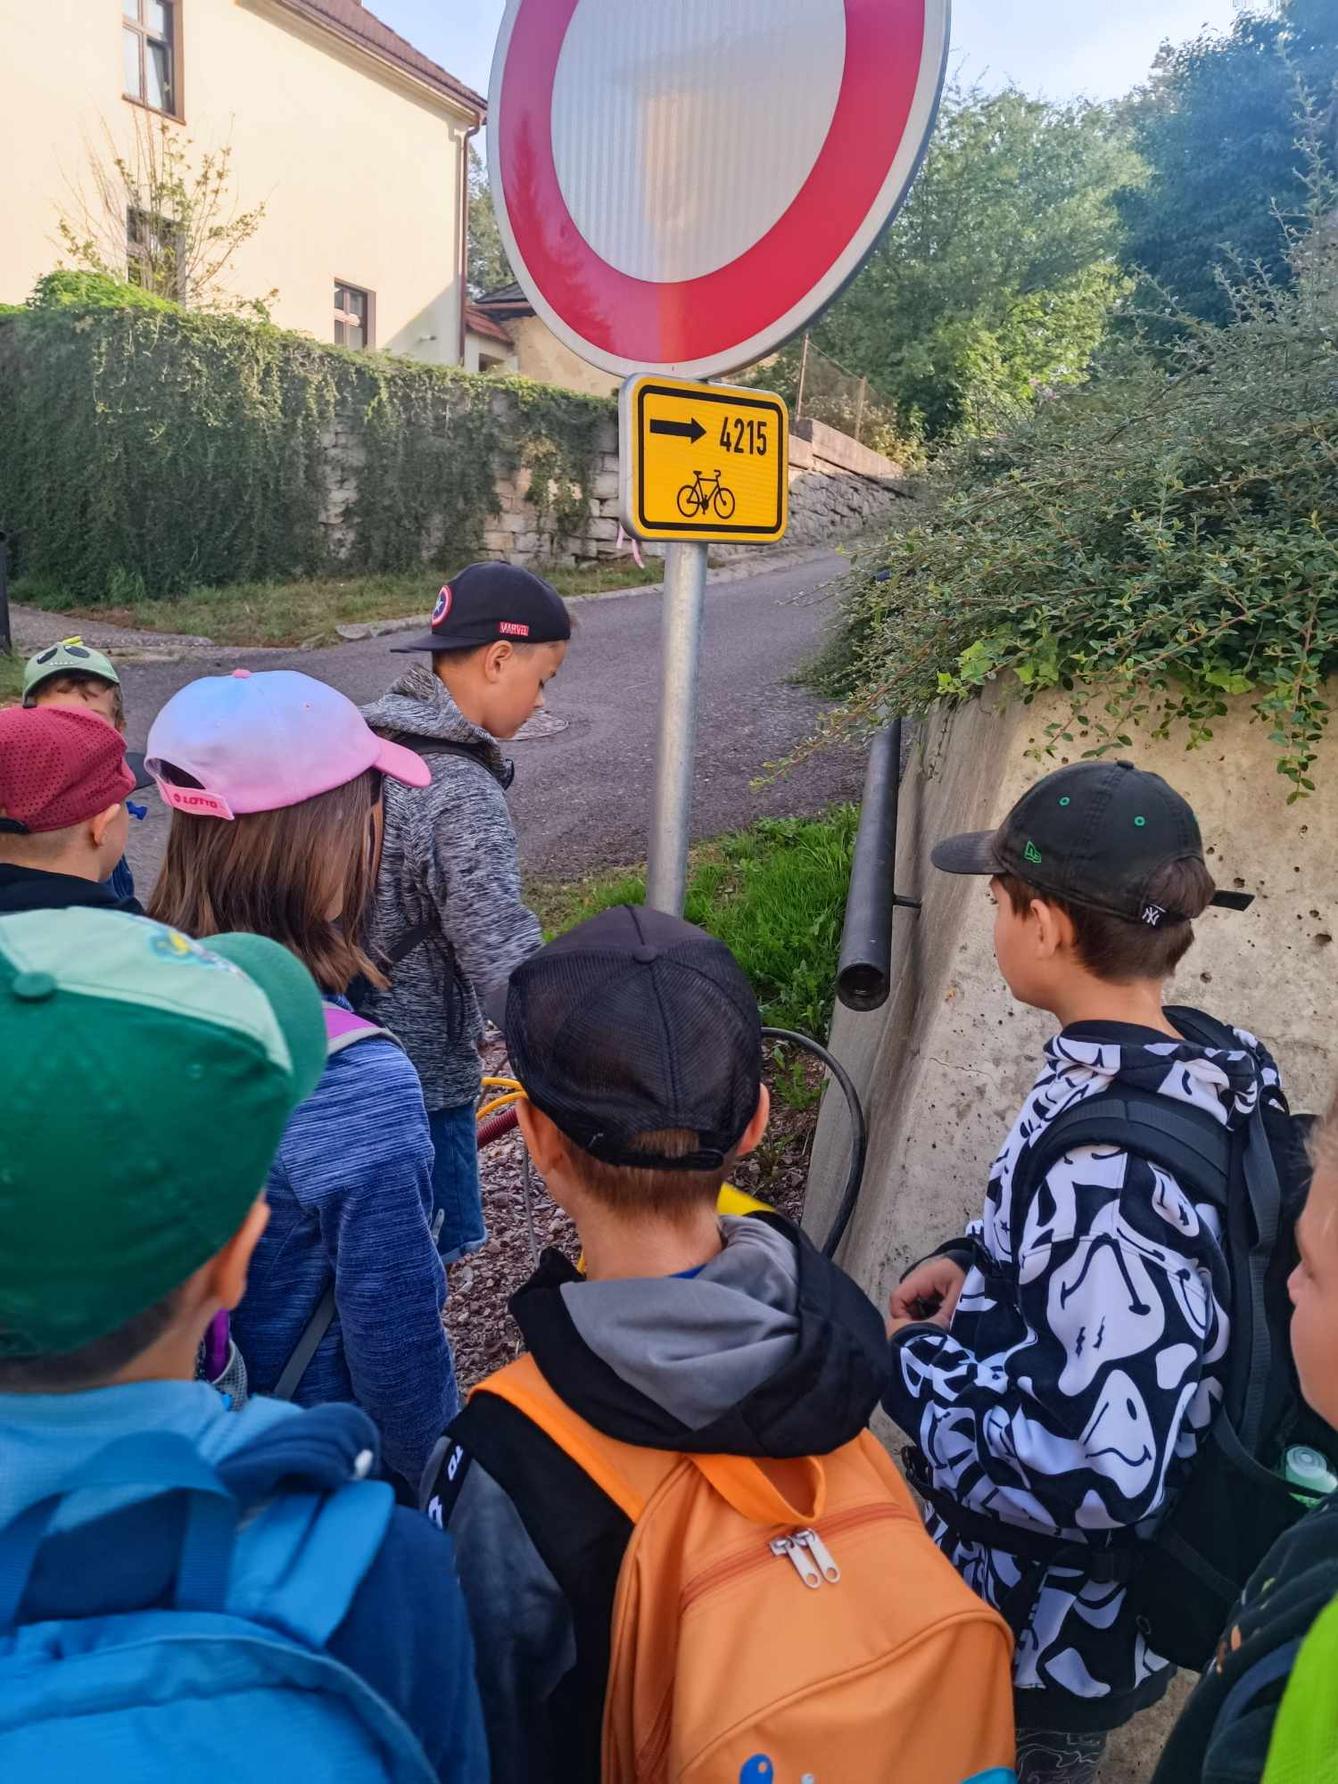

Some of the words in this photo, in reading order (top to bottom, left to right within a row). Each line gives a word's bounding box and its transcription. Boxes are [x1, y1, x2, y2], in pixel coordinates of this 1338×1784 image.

[720, 416, 767, 456] 4215
[500, 621, 529, 637] MARVEL
[183, 796, 218, 809] LOTTO
[1142, 906, 1160, 926] NY
